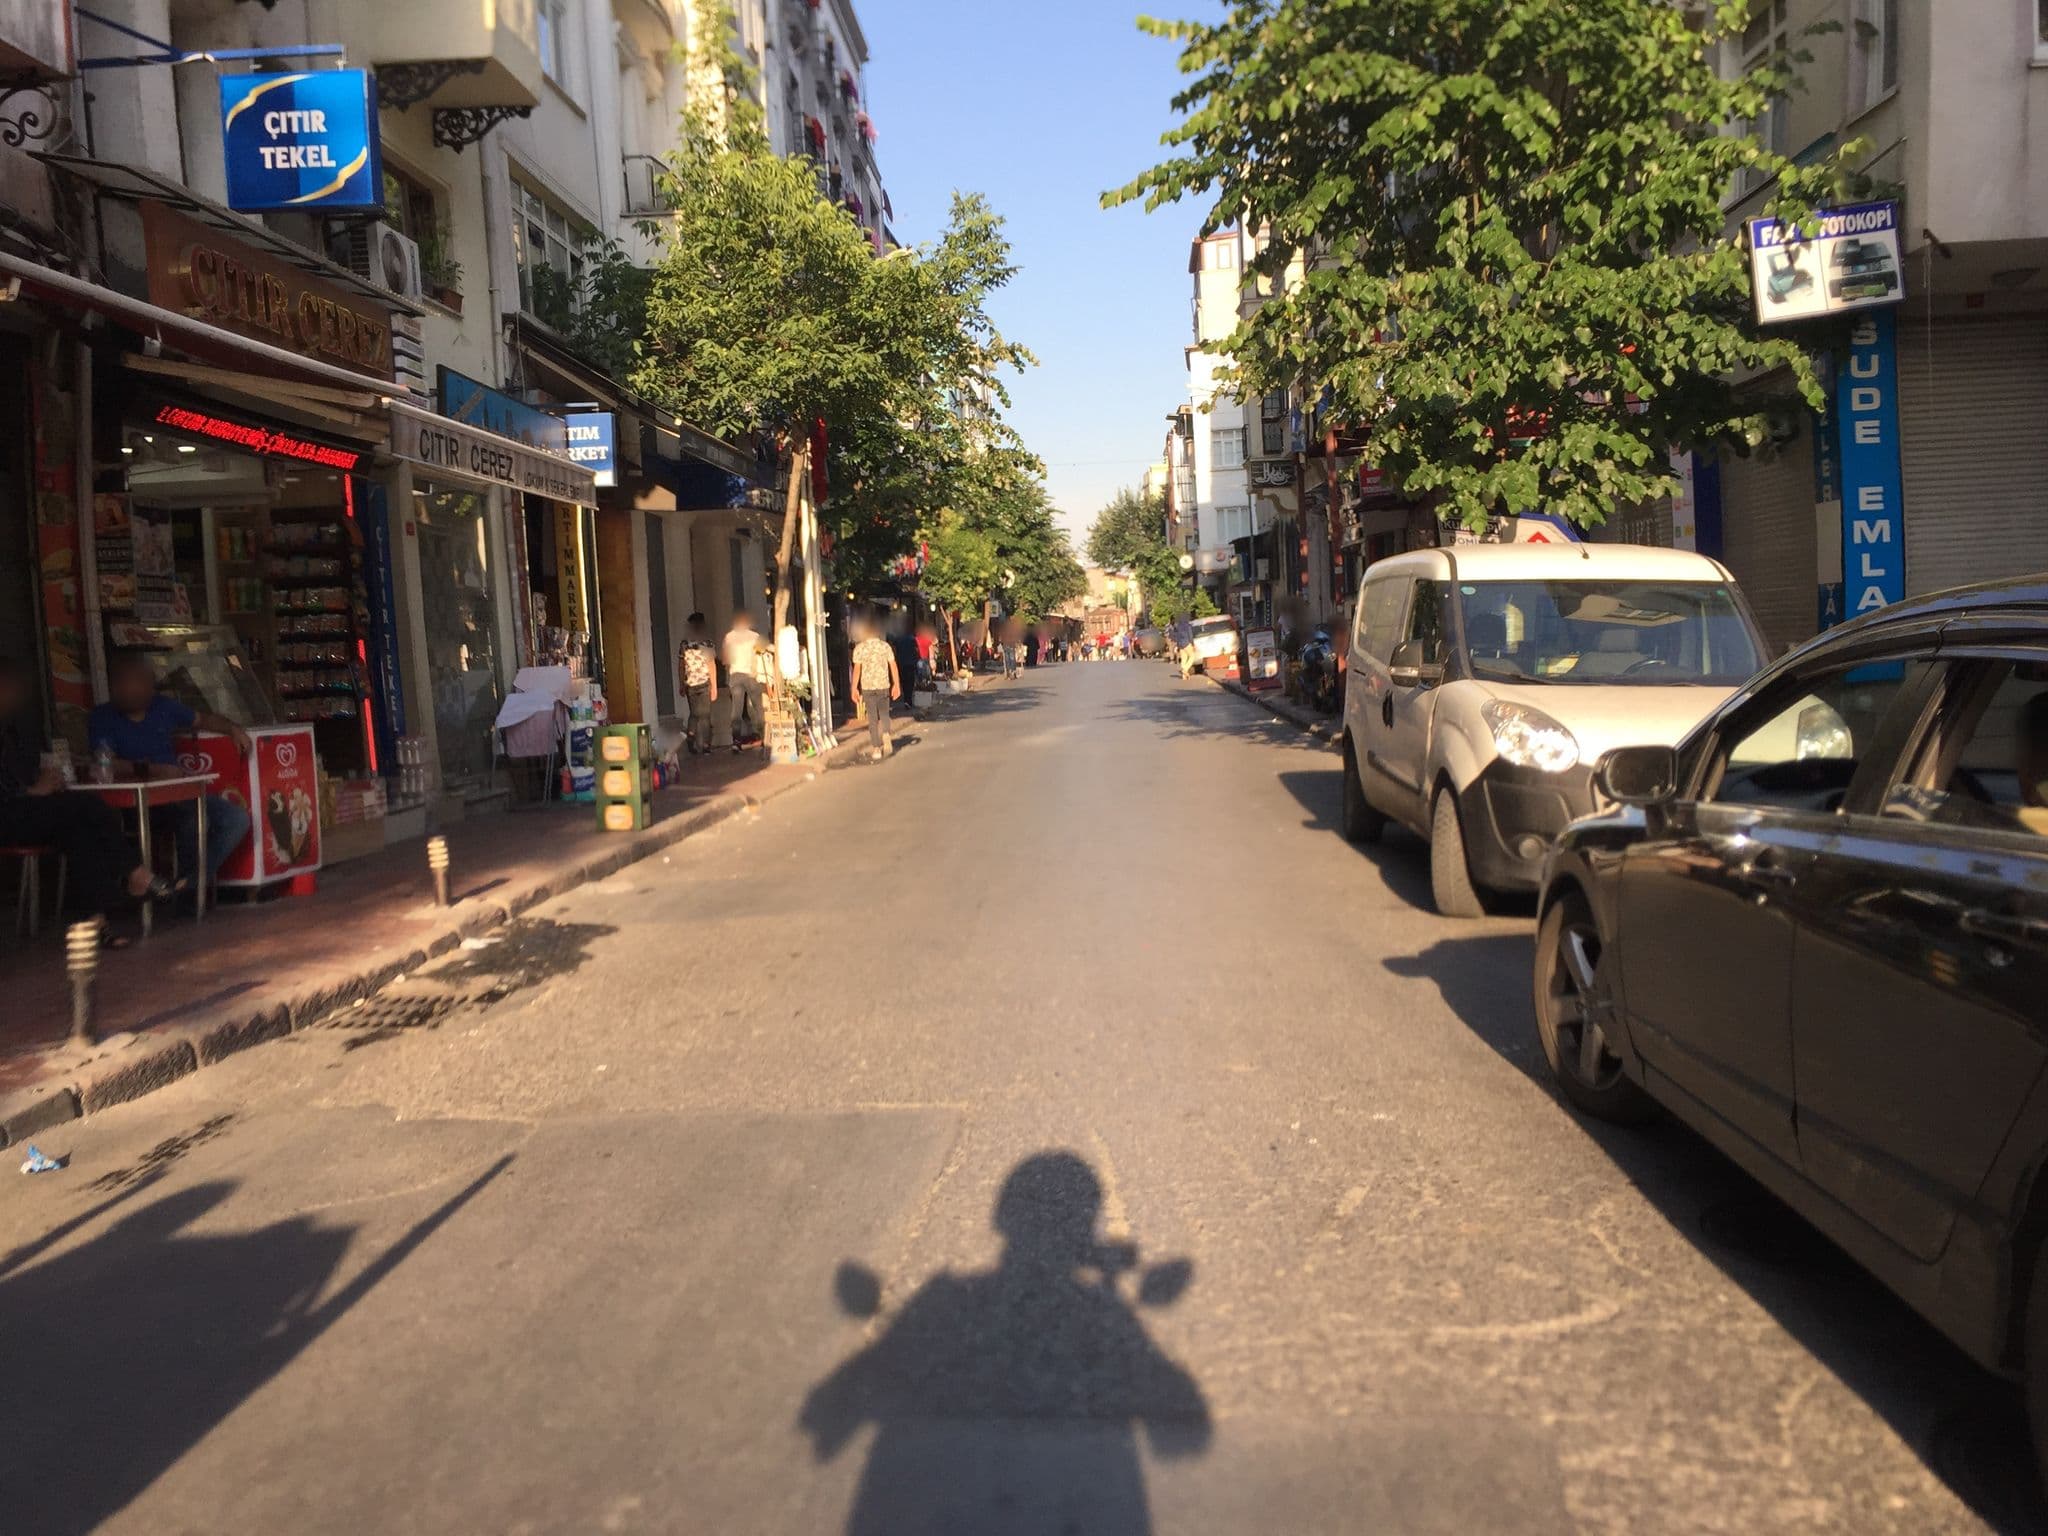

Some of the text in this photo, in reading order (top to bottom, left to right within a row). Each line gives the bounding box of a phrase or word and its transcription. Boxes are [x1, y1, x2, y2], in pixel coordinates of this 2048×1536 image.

[264, 110, 327, 140] ÇITIR
[259, 145, 336, 169] TEKEL
[190, 246, 294, 339] ÇITIR
[566, 425, 600, 441] TIM
[566, 445, 609, 461] RKET
[1850, 320, 1892, 612] SUDE EMLA
[560, 507, 579, 636] RTIM MARKE
